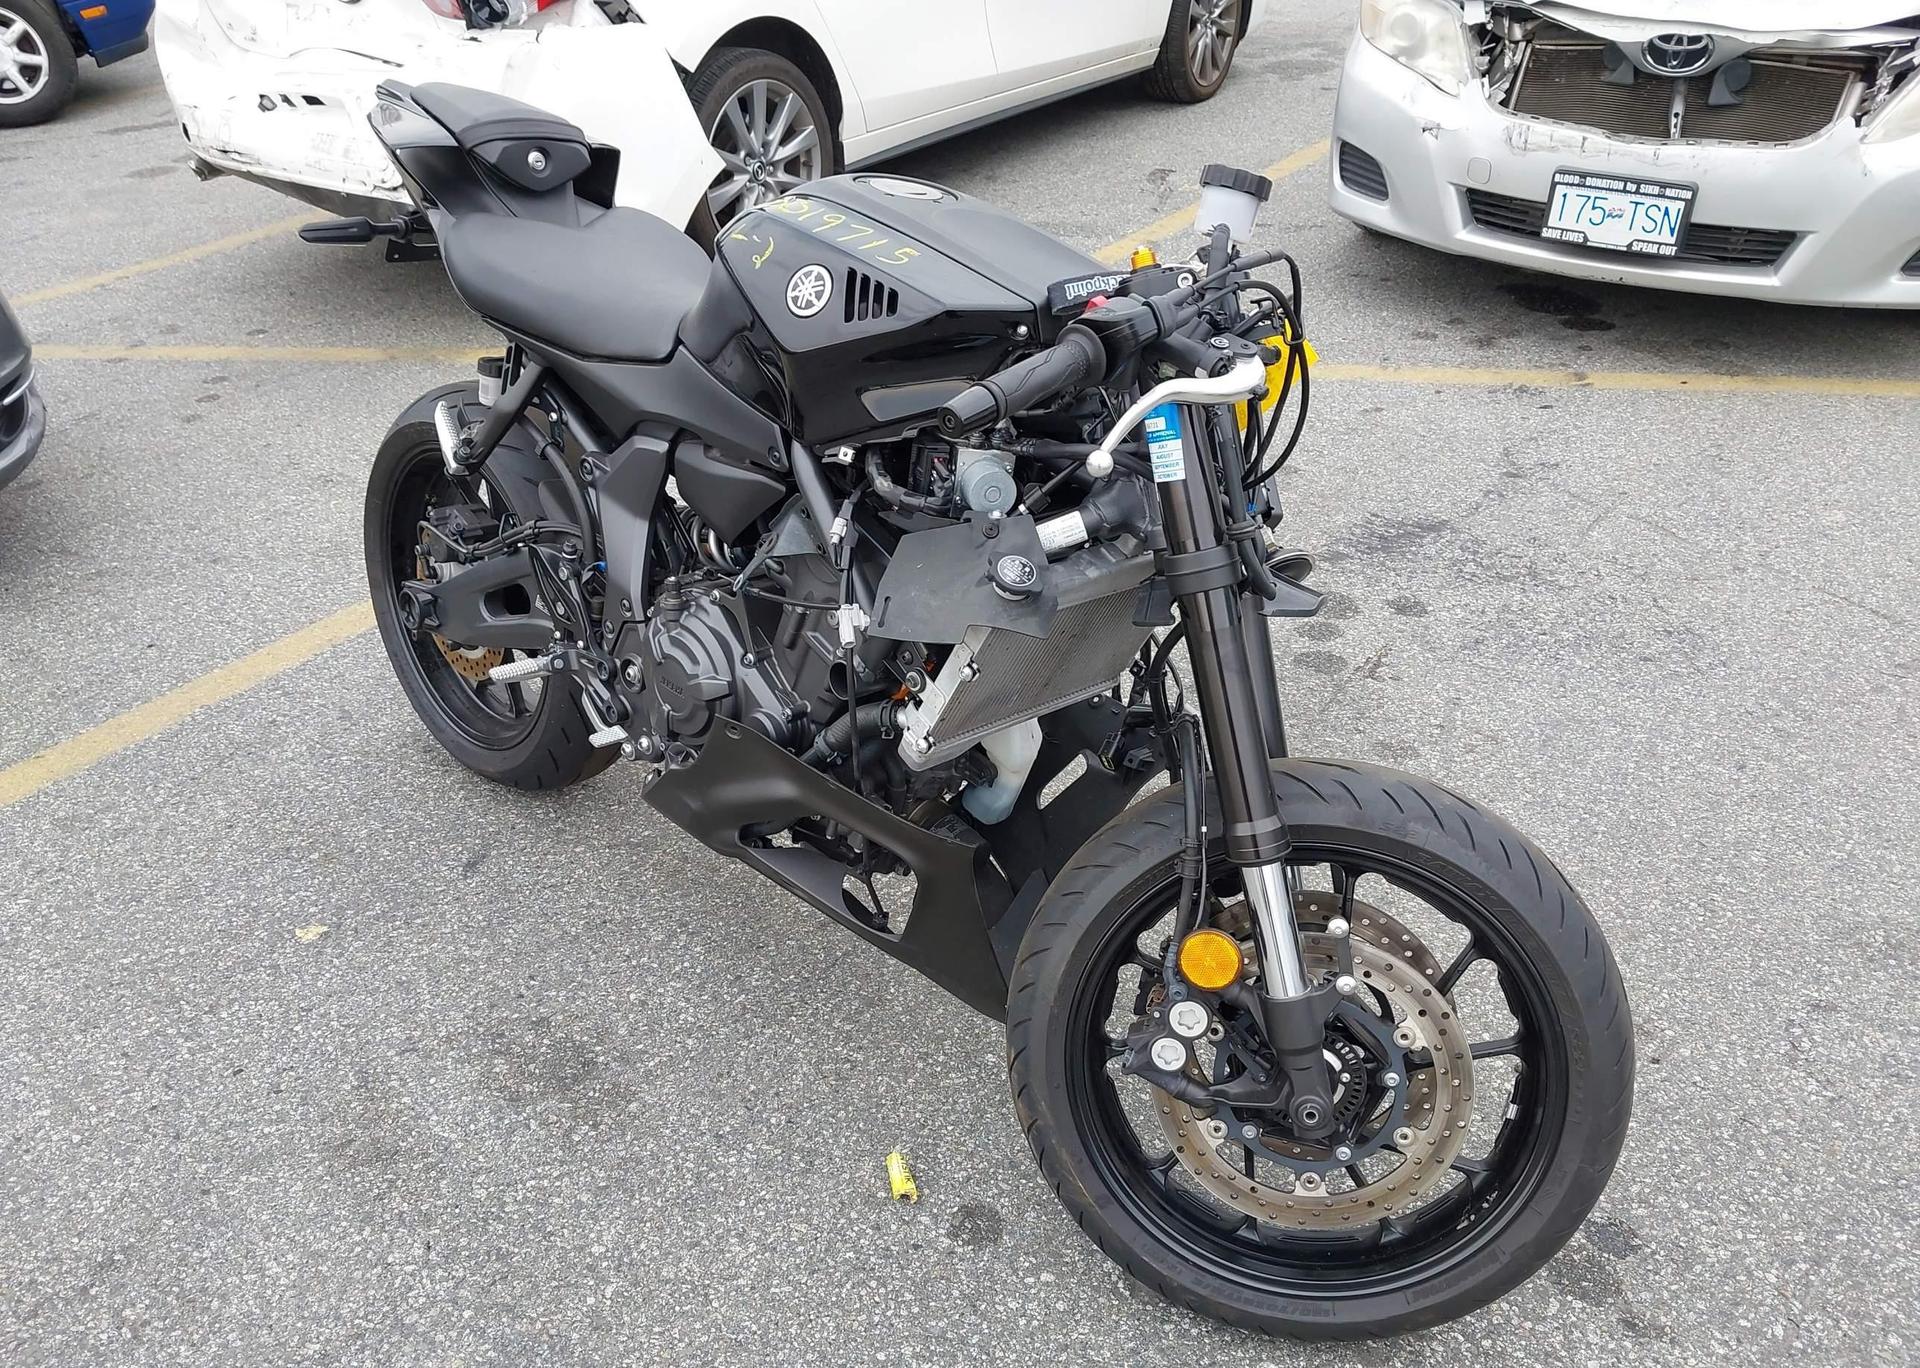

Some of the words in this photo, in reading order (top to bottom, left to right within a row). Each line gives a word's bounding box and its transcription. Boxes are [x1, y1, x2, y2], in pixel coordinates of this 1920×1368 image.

[1554, 173, 1580, 184] BLOOD
[1585, 176, 1625, 191] DONATION
[1626, 181, 1637, 192] by
[1640, 184, 1660, 195] SIKH
[1665, 187, 1693, 200] NATION
[1558, 192, 1608, 226] 175
[1628, 200, 1681, 238] TSN
[1541, 227, 1561, 240] SAVE
[1562, 230, 1585, 243] LIVES
[1632, 241, 1658, 254] SPEAK
[1659, 244, 1678, 256] OUT
